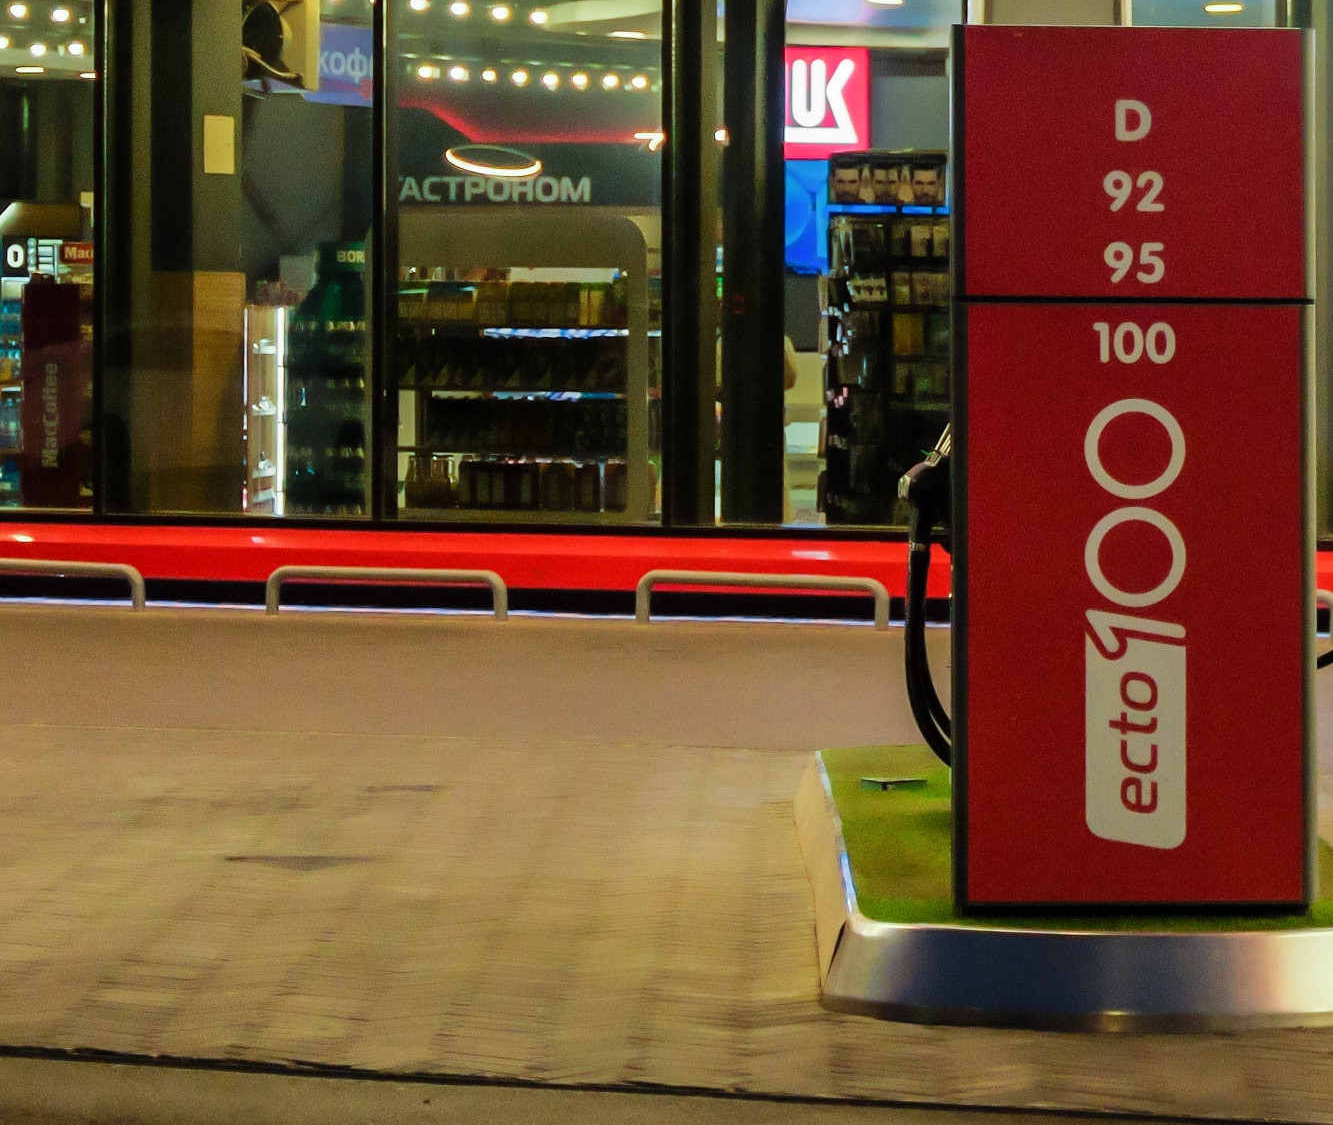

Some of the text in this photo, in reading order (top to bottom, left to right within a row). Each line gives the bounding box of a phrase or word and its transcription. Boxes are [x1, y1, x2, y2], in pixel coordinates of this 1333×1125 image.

[318, 46, 373, 84] коф
[1115, 99, 1152, 142] D
[399, 176, 592, 203] АСТРОНОМ
[1103, 170, 1165, 212] 92
[1103, 241, 1165, 284] 95
[1093, 322, 1176, 364] 100
[1108, 671, 1159, 814] ecto
